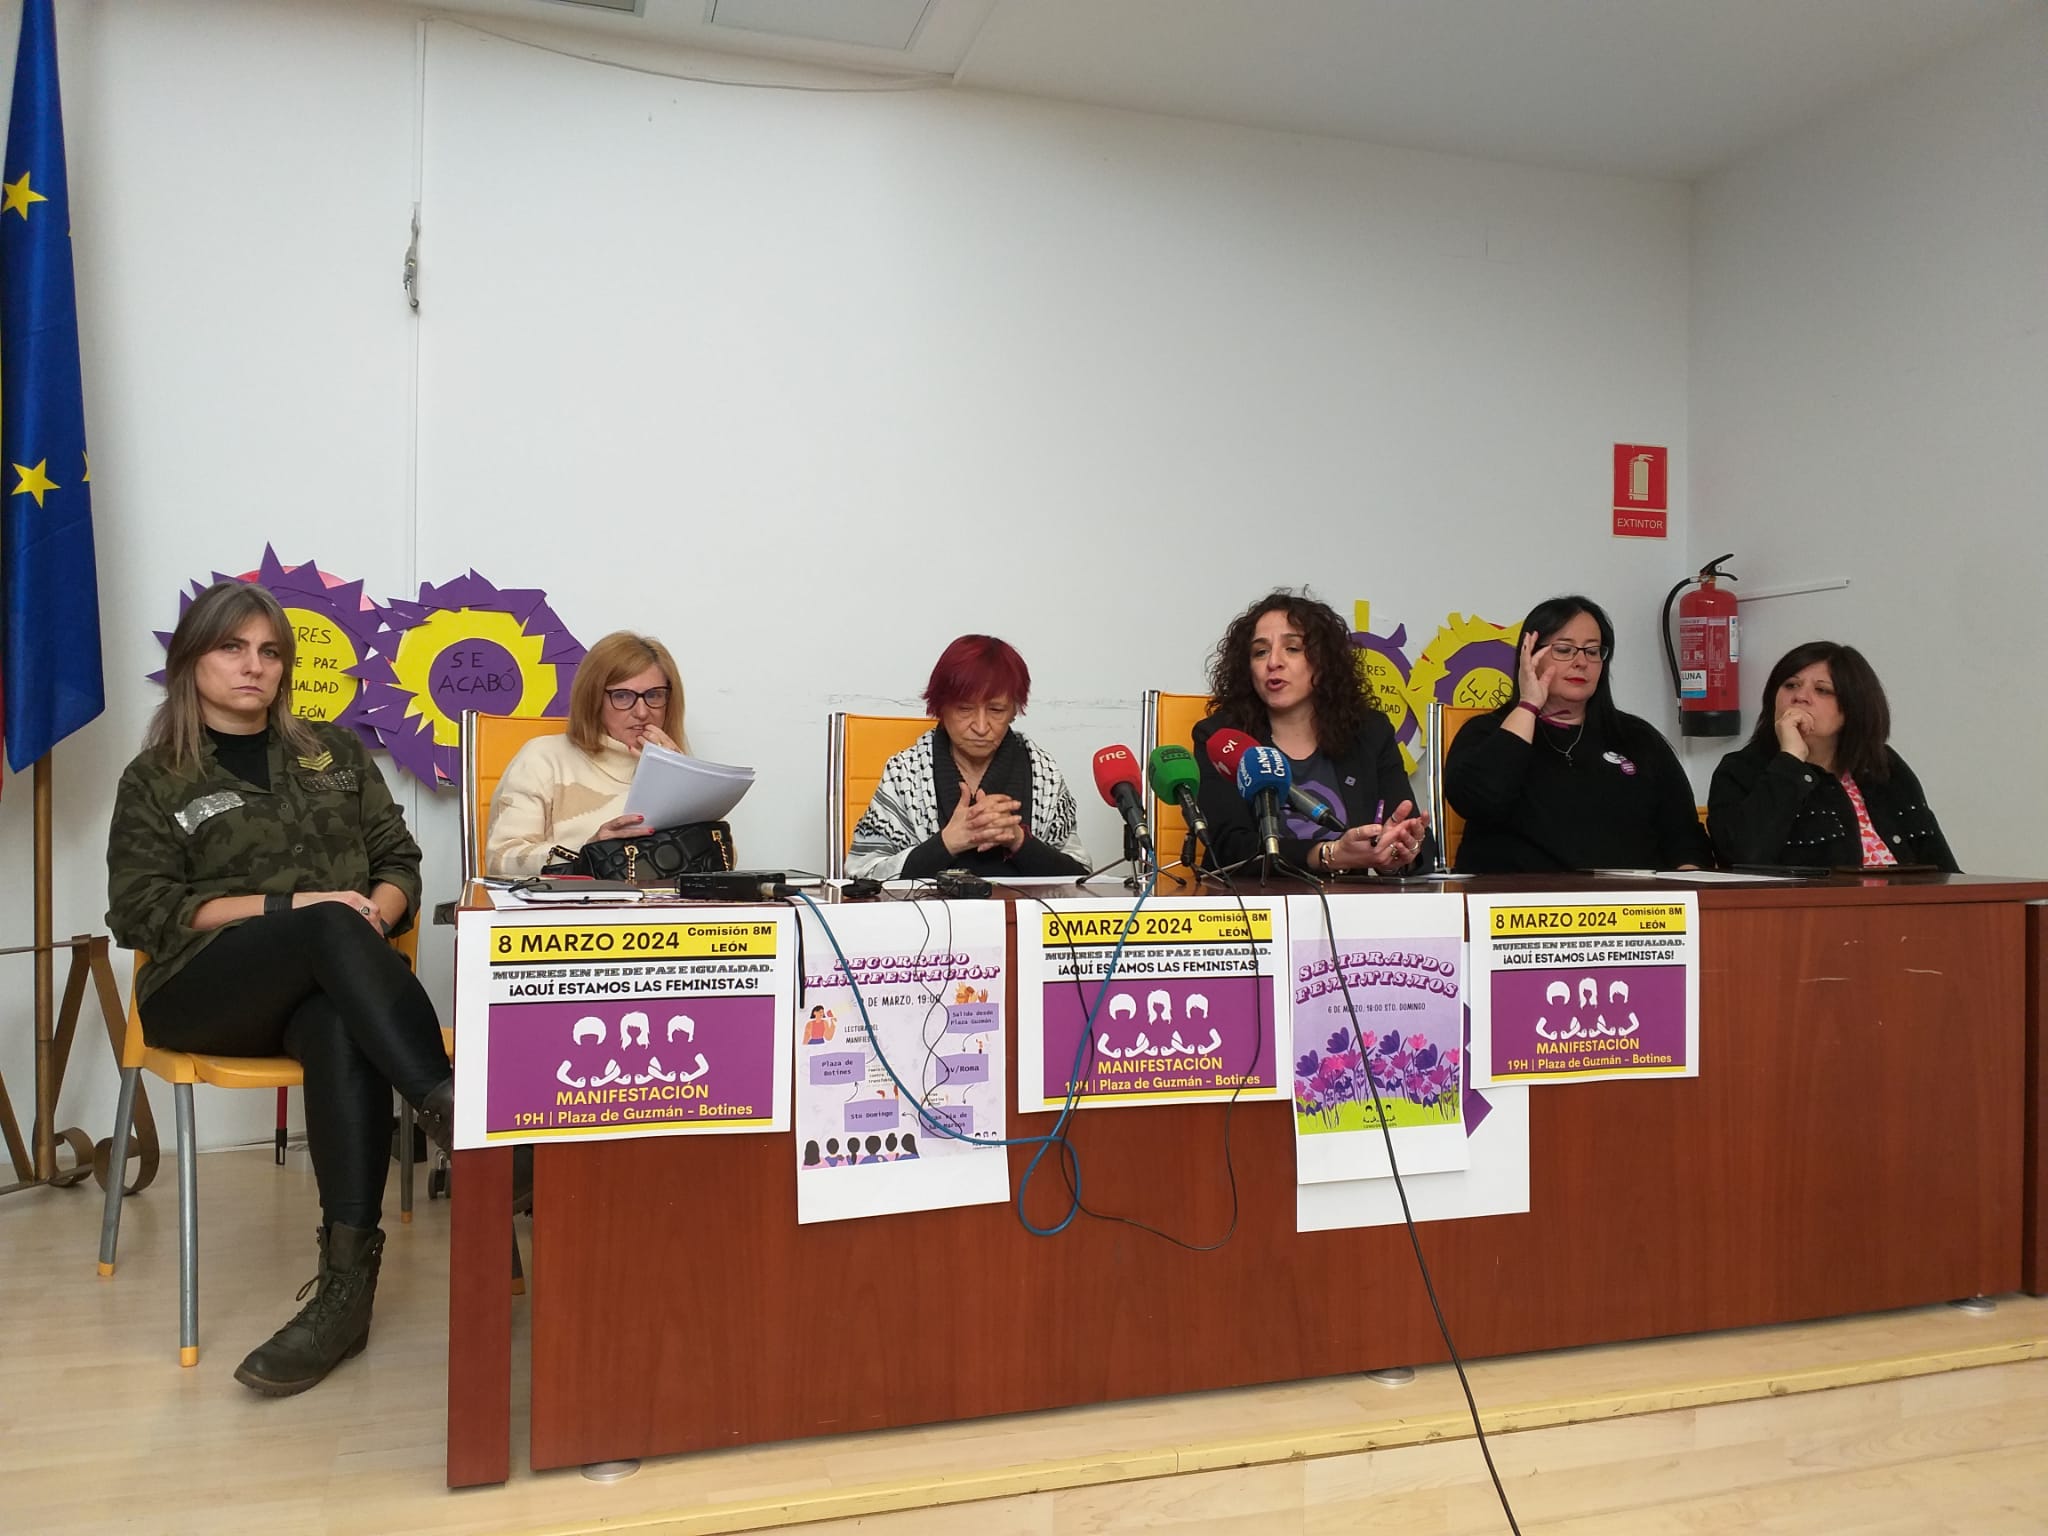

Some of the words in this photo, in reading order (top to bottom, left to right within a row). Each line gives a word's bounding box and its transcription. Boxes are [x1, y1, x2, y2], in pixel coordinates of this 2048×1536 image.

[1617, 518, 1663, 530] EXTINTOR
[292, 627, 331, 644] RES
[313, 656, 337, 669] PAZ
[450, 652, 485, 668] SE
[1366, 664, 1386, 676] RES
[438, 667, 516, 694] ACABÓ
[1380, 684, 1398, 695] PAZ
[1459, 677, 1488, 708] SE
[293, 704, 326, 718] EÓN
[1384, 703, 1401, 714] DAD
[1099, 750, 1126, 763] rne
[1198, 913, 1248, 922] Comisión
[1252, 913, 1268, 922] 8M
[1622, 907, 1666, 916] Comisión
[1668, 907, 1683, 916] 8M
[1049, 921, 1060, 937] 8
[1067, 919, 1140, 936] MARZO
[1146, 918, 1193, 934] 2024
[1496, 914, 1505, 929] 8
[1510, 912, 1574, 929] MARZO
[1578, 911, 1618, 927] 2024
[1639, 919, 1666, 930] LEÓN
[687, 926, 748, 936] Comisión
[752, 926, 772, 936] 8M
[1218, 926, 1249, 937] LEÓN
[498, 936, 512, 953] 8
[520, 933, 614, 953] MARZO
[622, 931, 680, 951] 2024
[711, 941, 748, 953] LEÓN
[1492, 942, 1541, 951] MUJERES
[1543, 941, 1559, 949] EN
[1560, 941, 1578, 949] PIE
[1578, 940, 1593, 948] DE
[1594, 940, 1616, 948] PAZ
[1625, 939, 1686, 947] IGUALDAD.
[833, 952, 970, 971] RECORRIDO
[1045, 951, 1103, 960] MUJERES
[1124, 949, 1146, 958] PIE
[1147, 949, 1165, 958] DE
[1166, 948, 1192, 957] PAZ
[1193, 948, 1201, 957] E
[1203, 947, 1272, 957] IGUALDAD.
[1503, 951, 1533, 965] ¡AQUÍ
[1535, 952, 1585, 963] ESTAMOS
[1587, 951, 1606, 962] LAS
[1607, 949, 1675, 961] FEMINISTAS!
[492, 967, 568, 980] MUJERES
[569, 967, 592, 978] EN
[594, 966, 621, 977] PIE
[622, 966, 643, 976] DE
[645, 965, 677, 976] PAZ
[678, 965, 688, 975] E
[689, 964, 774, 975] IGUALDAD.
[1097, 961, 1155, 975] ESTAMOS
[1157, 960, 1180, 973] LAS
[1299, 951, 1455, 982] SEMBRANDO
[804, 965, 1001, 989] MANIFESTACIÓN
[509, 979, 555, 997] ¡AQUÍ
[558, 980, 632, 995] ESTAMOS
[634, 979, 662, 993] LAS
[665, 977, 759, 991] FEMINISTAS!
[1296, 970, 1459, 1004] FEMINISMOS
[868, 997, 878, 1007] DE
[1536, 1035, 1640, 1055] MANIFESTACIÓN
[1098, 1054, 1222, 1074] MANIFESTACIÓN
[1507, 1060, 1528, 1070] 19H
[1538, 1057, 1566, 1069] Plaza
[1568, 1056, 1581, 1067] de
[1583, 1054, 1622, 1066] Guzmán
[1632, 1052, 1672, 1064] Botines
[1100, 1078, 1131, 1091] Plaza
[1134, 1077, 1149, 1089] de
[1153, 1075, 1203, 1088] Guzmán
[556, 1082, 709, 1106] MANIFESTACIÓN
[514, 1112, 545, 1126] 19H
[558, 1110, 598, 1124] Plaza
[601, 1107, 619, 1122] de
[623, 1105, 684, 1121] Guzmán
[699, 1103, 753, 1117] Botines
